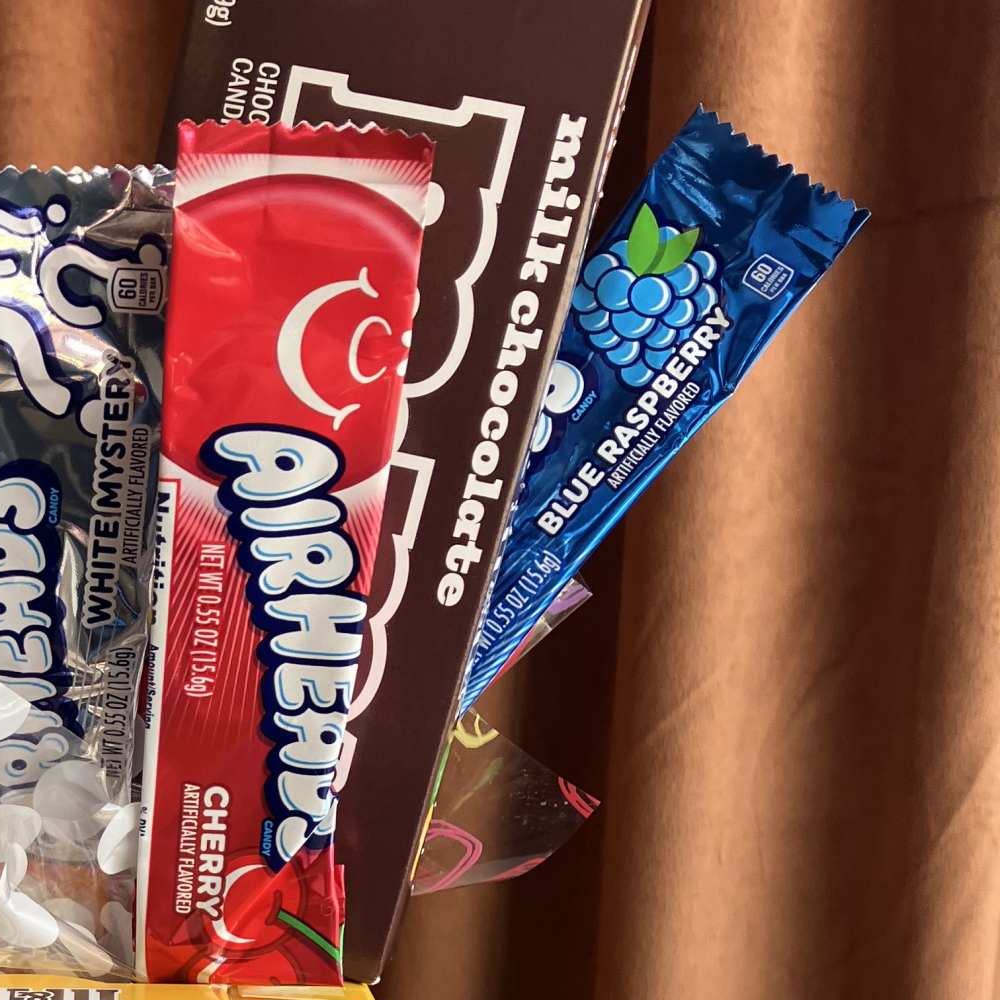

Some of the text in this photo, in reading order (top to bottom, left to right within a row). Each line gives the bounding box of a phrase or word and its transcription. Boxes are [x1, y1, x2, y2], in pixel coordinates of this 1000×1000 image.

[519, 113, 587, 285] milk
[118, 278, 138, 300] 60
[751, 263, 772, 283] 60
[436, 289, 543, 608] chocolate
[537, 305, 730, 536] BLUE RASPBERRY
[571, 390, 598, 422] CANDY
[607, 381, 701, 490] ARTIFICIALLY FLAVORED
[48, 487, 61, 525] CANDY
[86, 356, 132, 626] WHITE MYSTERY
[122, 427, 149, 565] ARTIFICIALLY FLAVORED
[183, 543, 226, 699] NET WT 0.55 OZ (15.6g)
[486, 602, 516, 634] 0.55
[504, 586, 530, 609] OZ
[517, 549, 563, 595] (15.6g)
[107, 647, 136, 691] (15.6g)
[214, 430, 368, 862] AIRHEADS
[102, 737, 126, 756] WT
[103, 709, 126, 738] 0.55
[105, 690, 127, 709] OZ
[175, 783, 201, 915] ARTIFICIALLY FLAVORED
[196, 785, 230, 920] CHERRY
[262, 819, 274, 858] CANDY
